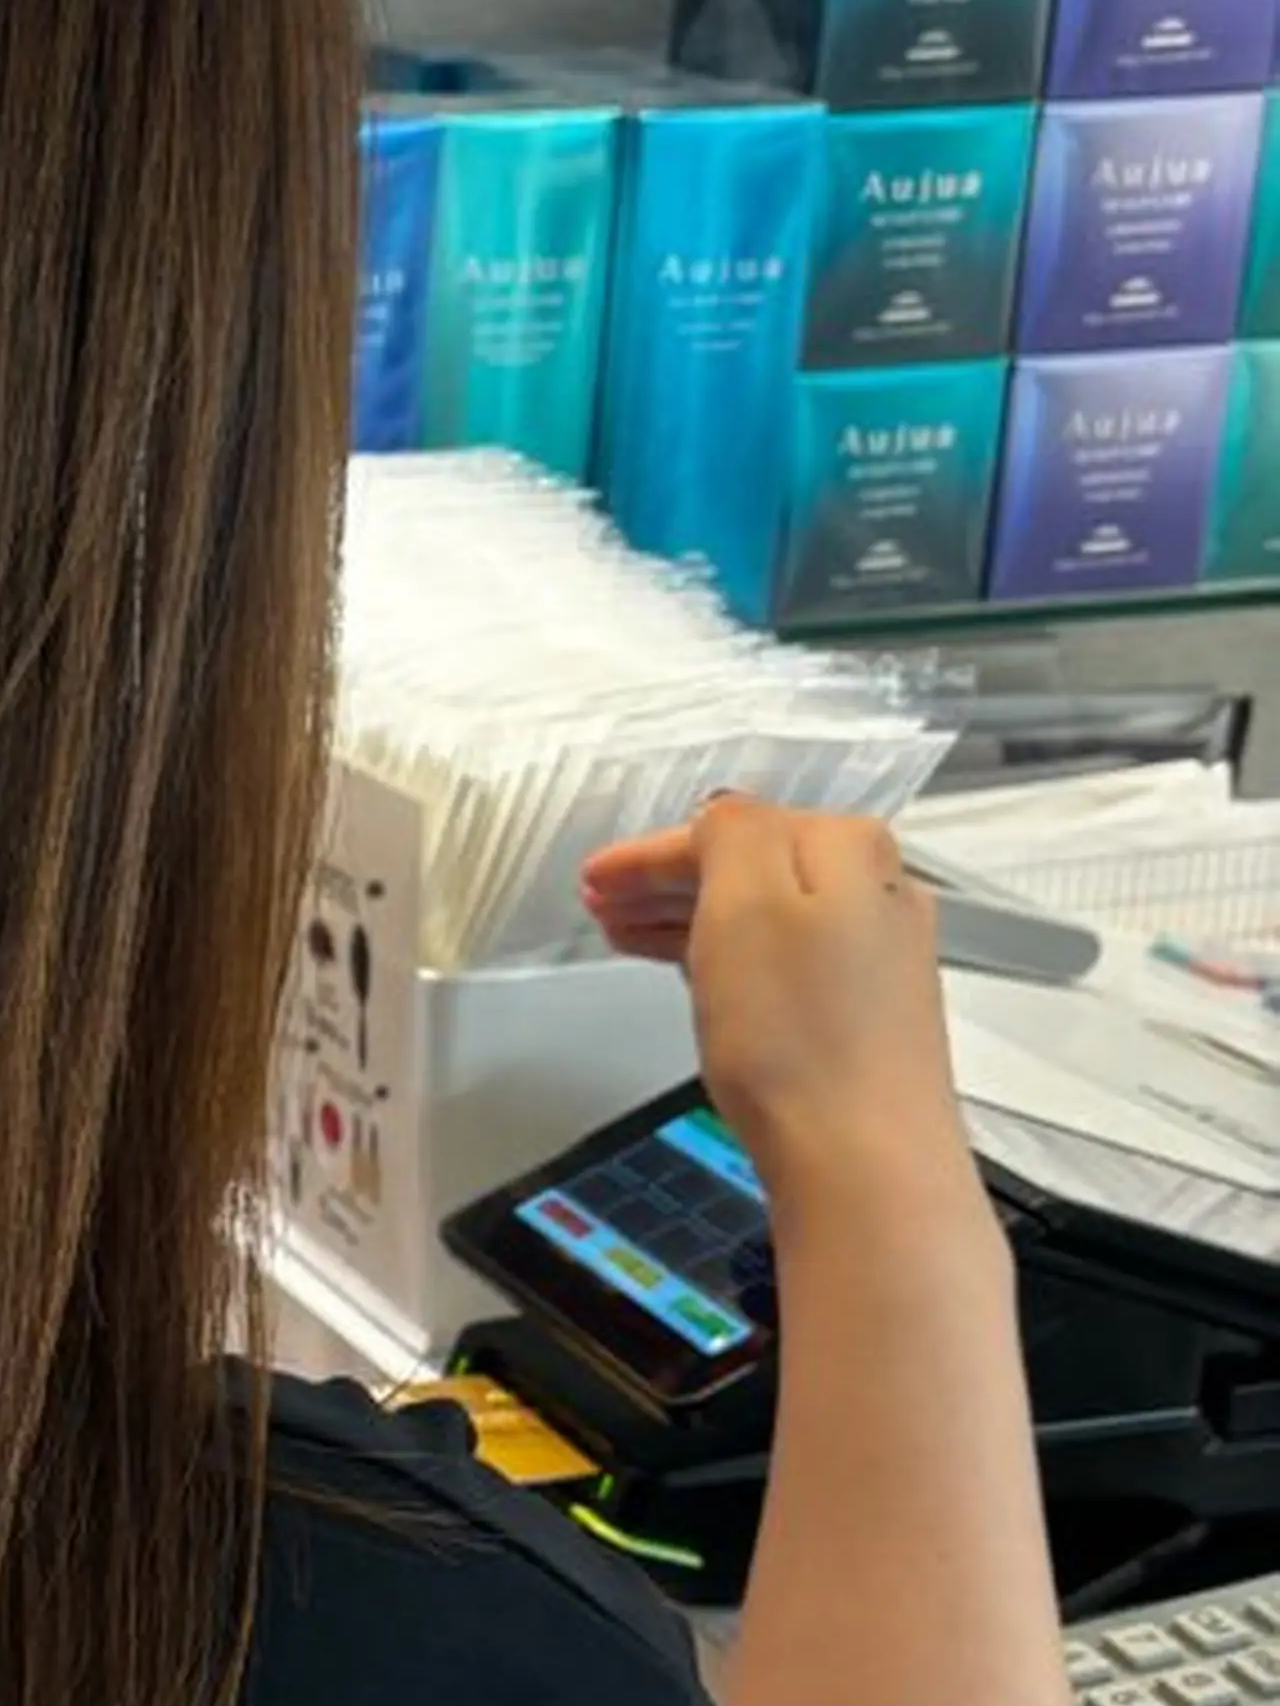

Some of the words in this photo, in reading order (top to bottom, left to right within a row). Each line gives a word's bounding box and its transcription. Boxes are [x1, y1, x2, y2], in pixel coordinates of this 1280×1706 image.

[859, 169, 981, 204] Aujua
[1091, 156, 1212, 191] Aujua
[657, 253, 784, 288] Aujua
[837, 421, 956, 456] Aujua
[1062, 409, 1181, 441] Aujua
